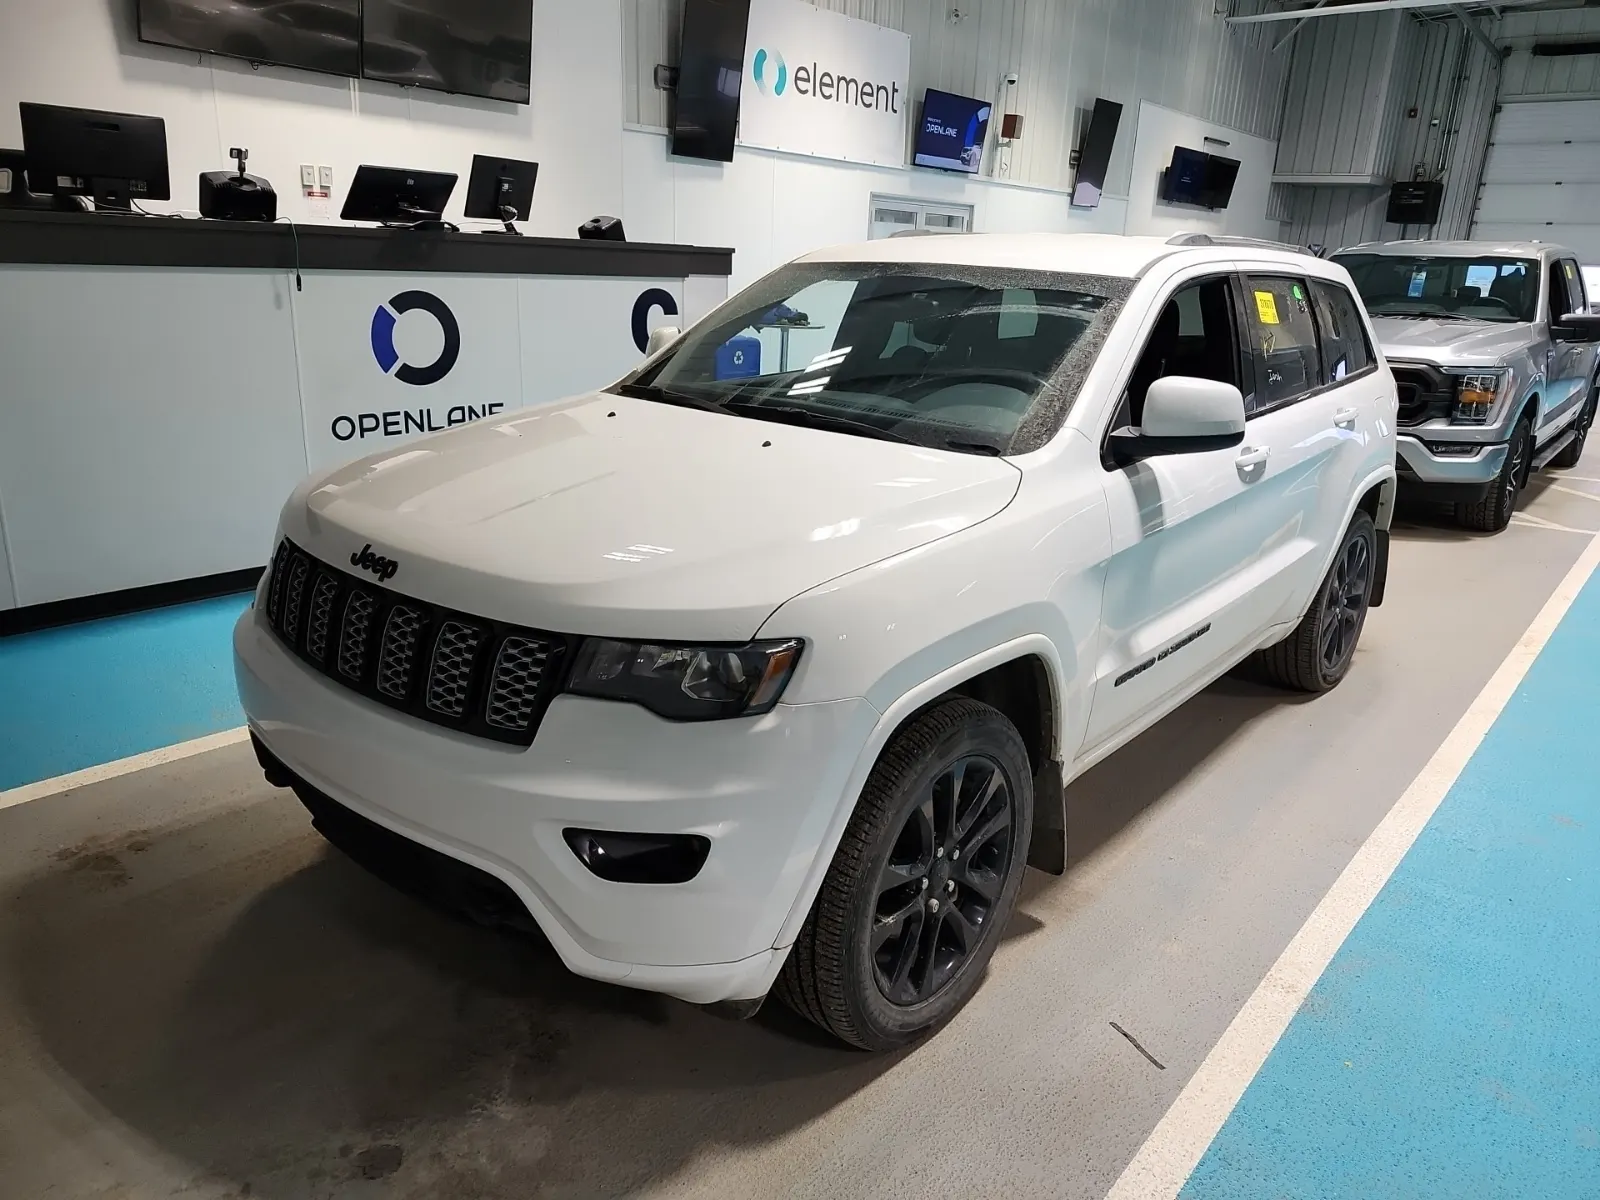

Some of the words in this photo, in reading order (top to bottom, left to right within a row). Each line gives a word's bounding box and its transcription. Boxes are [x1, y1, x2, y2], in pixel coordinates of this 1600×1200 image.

[794, 62, 899, 114] element
[926, 123, 958, 138] OPENLANE
[350, 543, 399, 583] Jeep
